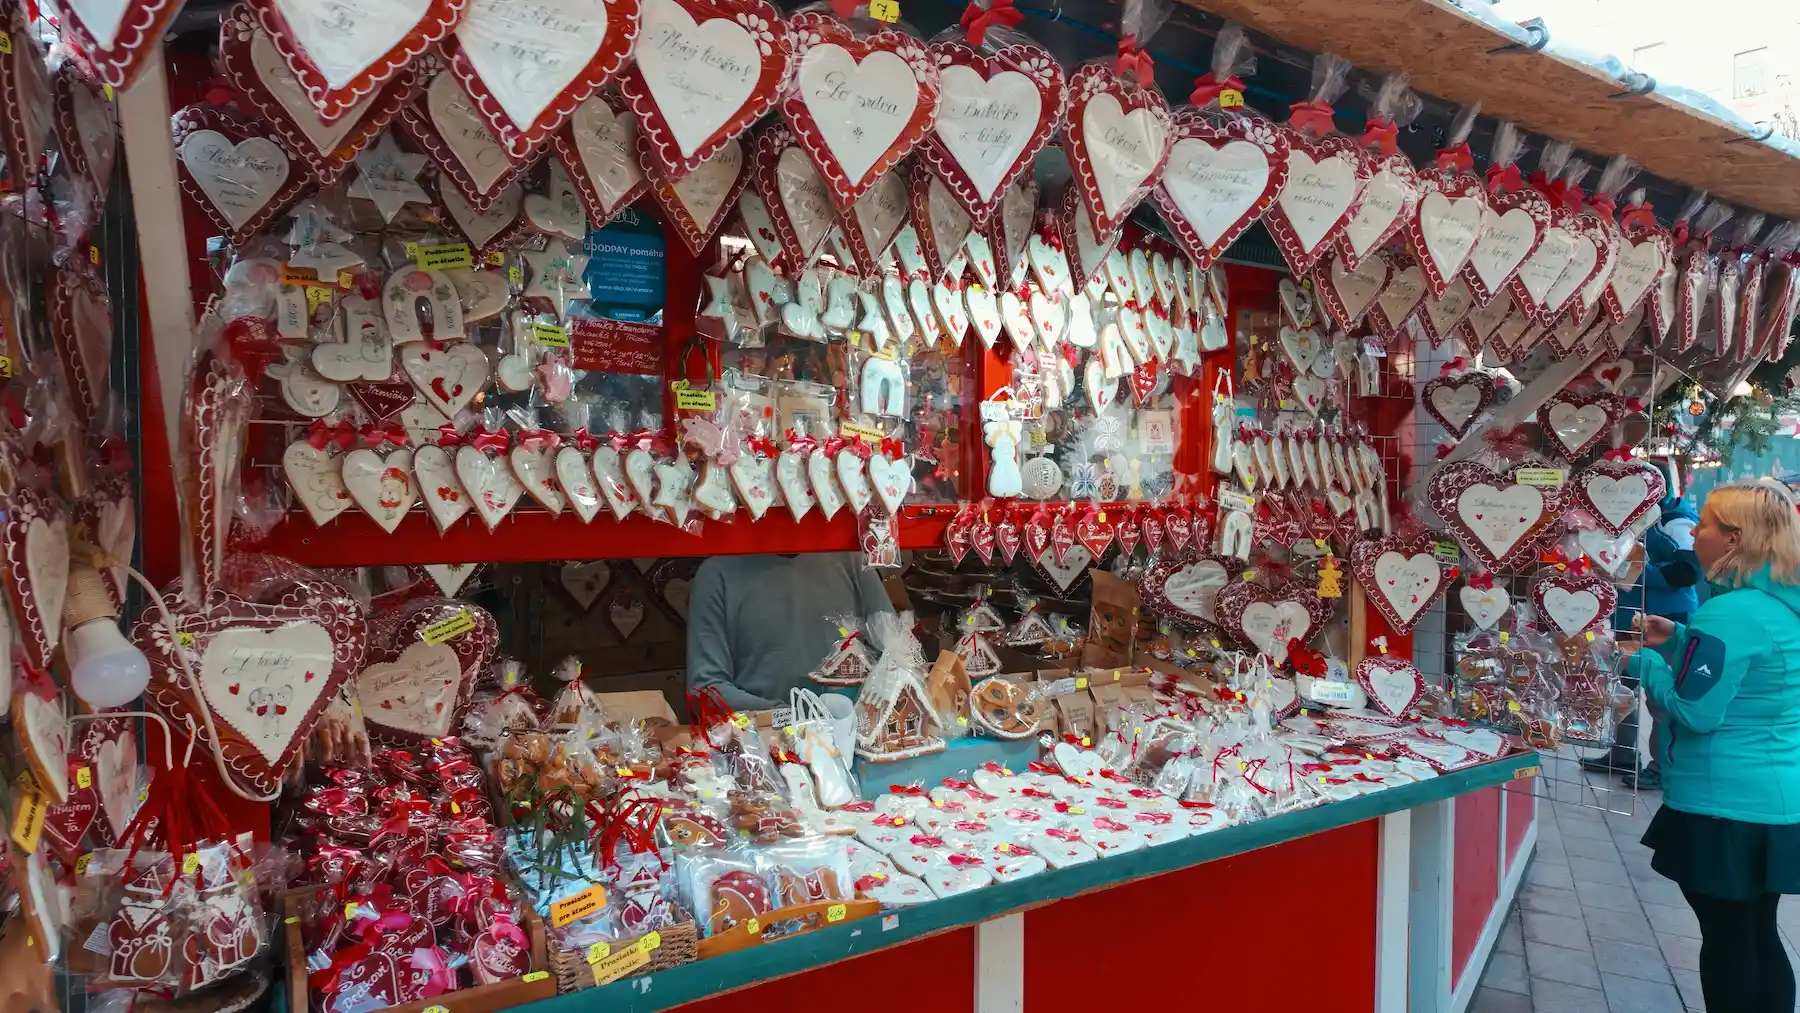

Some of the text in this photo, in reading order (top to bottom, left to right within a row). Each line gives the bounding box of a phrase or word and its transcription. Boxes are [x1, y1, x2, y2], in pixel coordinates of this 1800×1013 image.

[584, 243, 664, 259] GOODPAY pomáha
[559, 892, 593, 910] Prasiatko
[558, 902, 596, 922] pre šťastie
[342, 962, 389, 1010] Dedkovi
